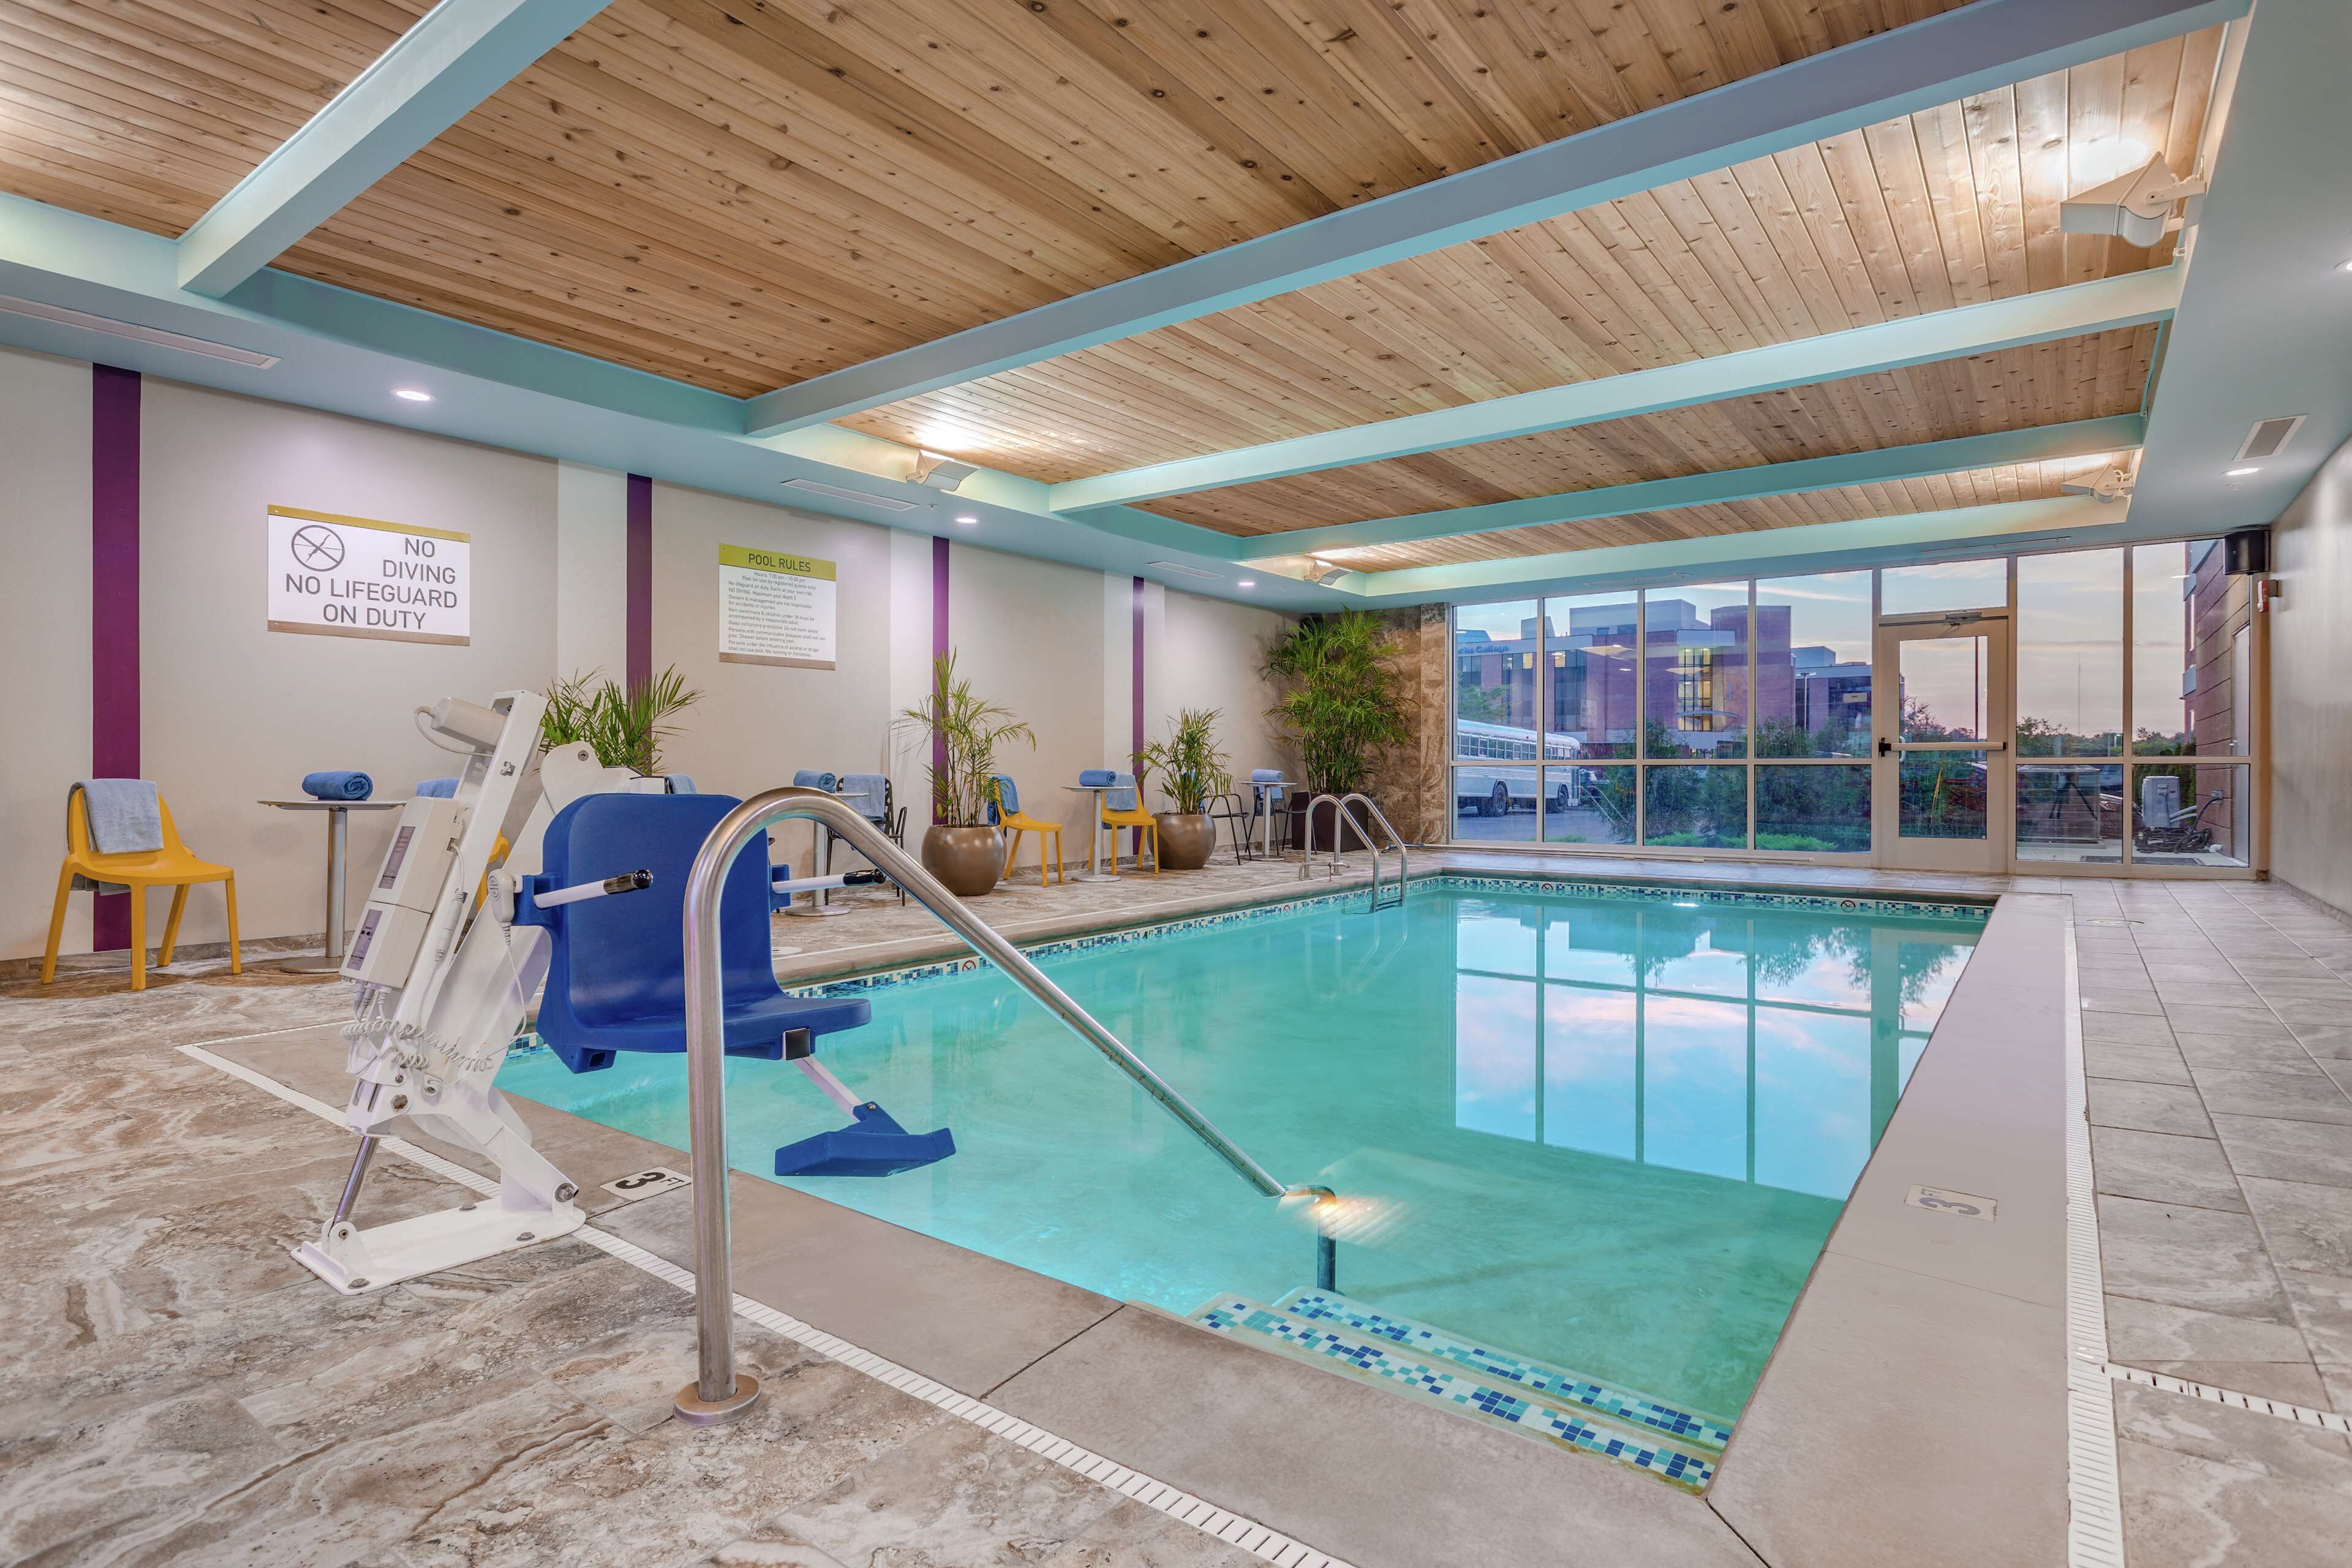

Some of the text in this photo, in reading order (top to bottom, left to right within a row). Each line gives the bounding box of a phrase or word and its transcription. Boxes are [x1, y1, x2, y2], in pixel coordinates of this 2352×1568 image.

[405, 537, 435, 558] NO
[383, 559, 456, 584] DIVING
[748, 553, 811, 572] POOL RULES
[286, 573, 457, 608] NO LIFEGUARD
[323, 603, 426, 630] ON DUTY
[1142, 930, 1148, 939] 4
[615, 1172, 685, 1189] 3 FT
[1919, 1197, 1981, 1215] 3
